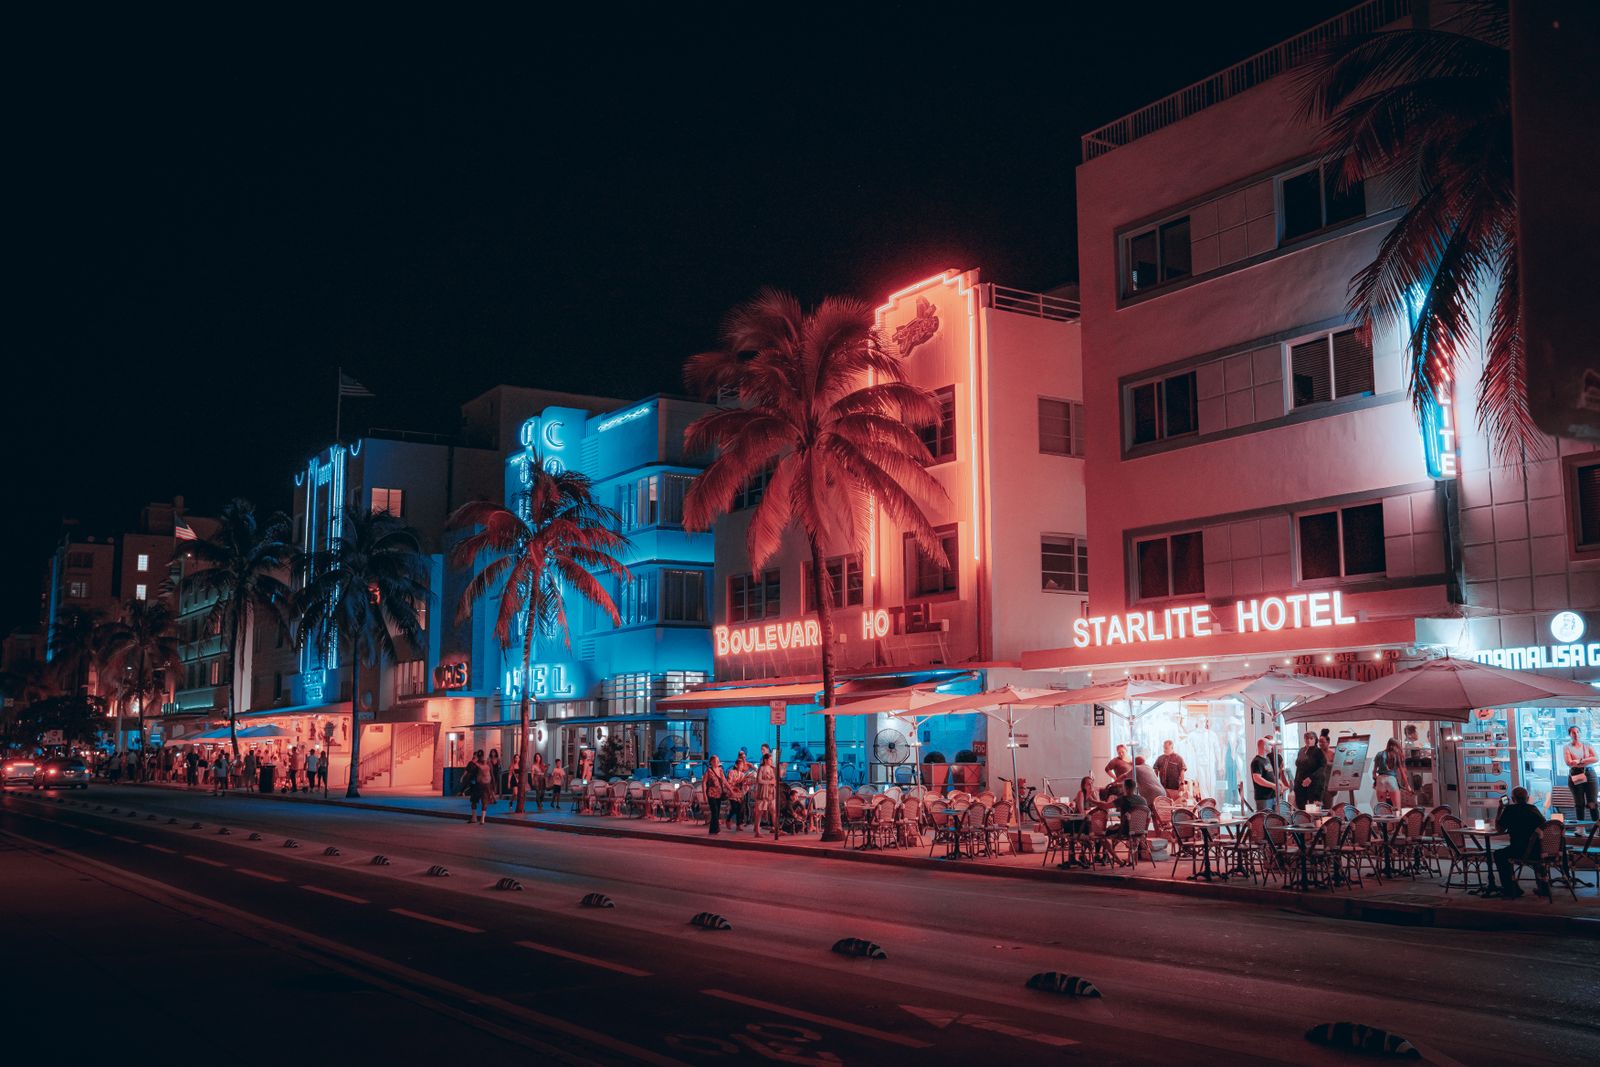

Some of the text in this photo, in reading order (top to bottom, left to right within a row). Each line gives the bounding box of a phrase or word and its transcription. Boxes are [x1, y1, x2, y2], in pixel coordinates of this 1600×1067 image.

[715, 603, 942, 657] BOULEVAR HOTEL
[1073, 590, 1356, 648] STARLITE HOTEL
[1473, 643, 1585, 670] MAMALISA
